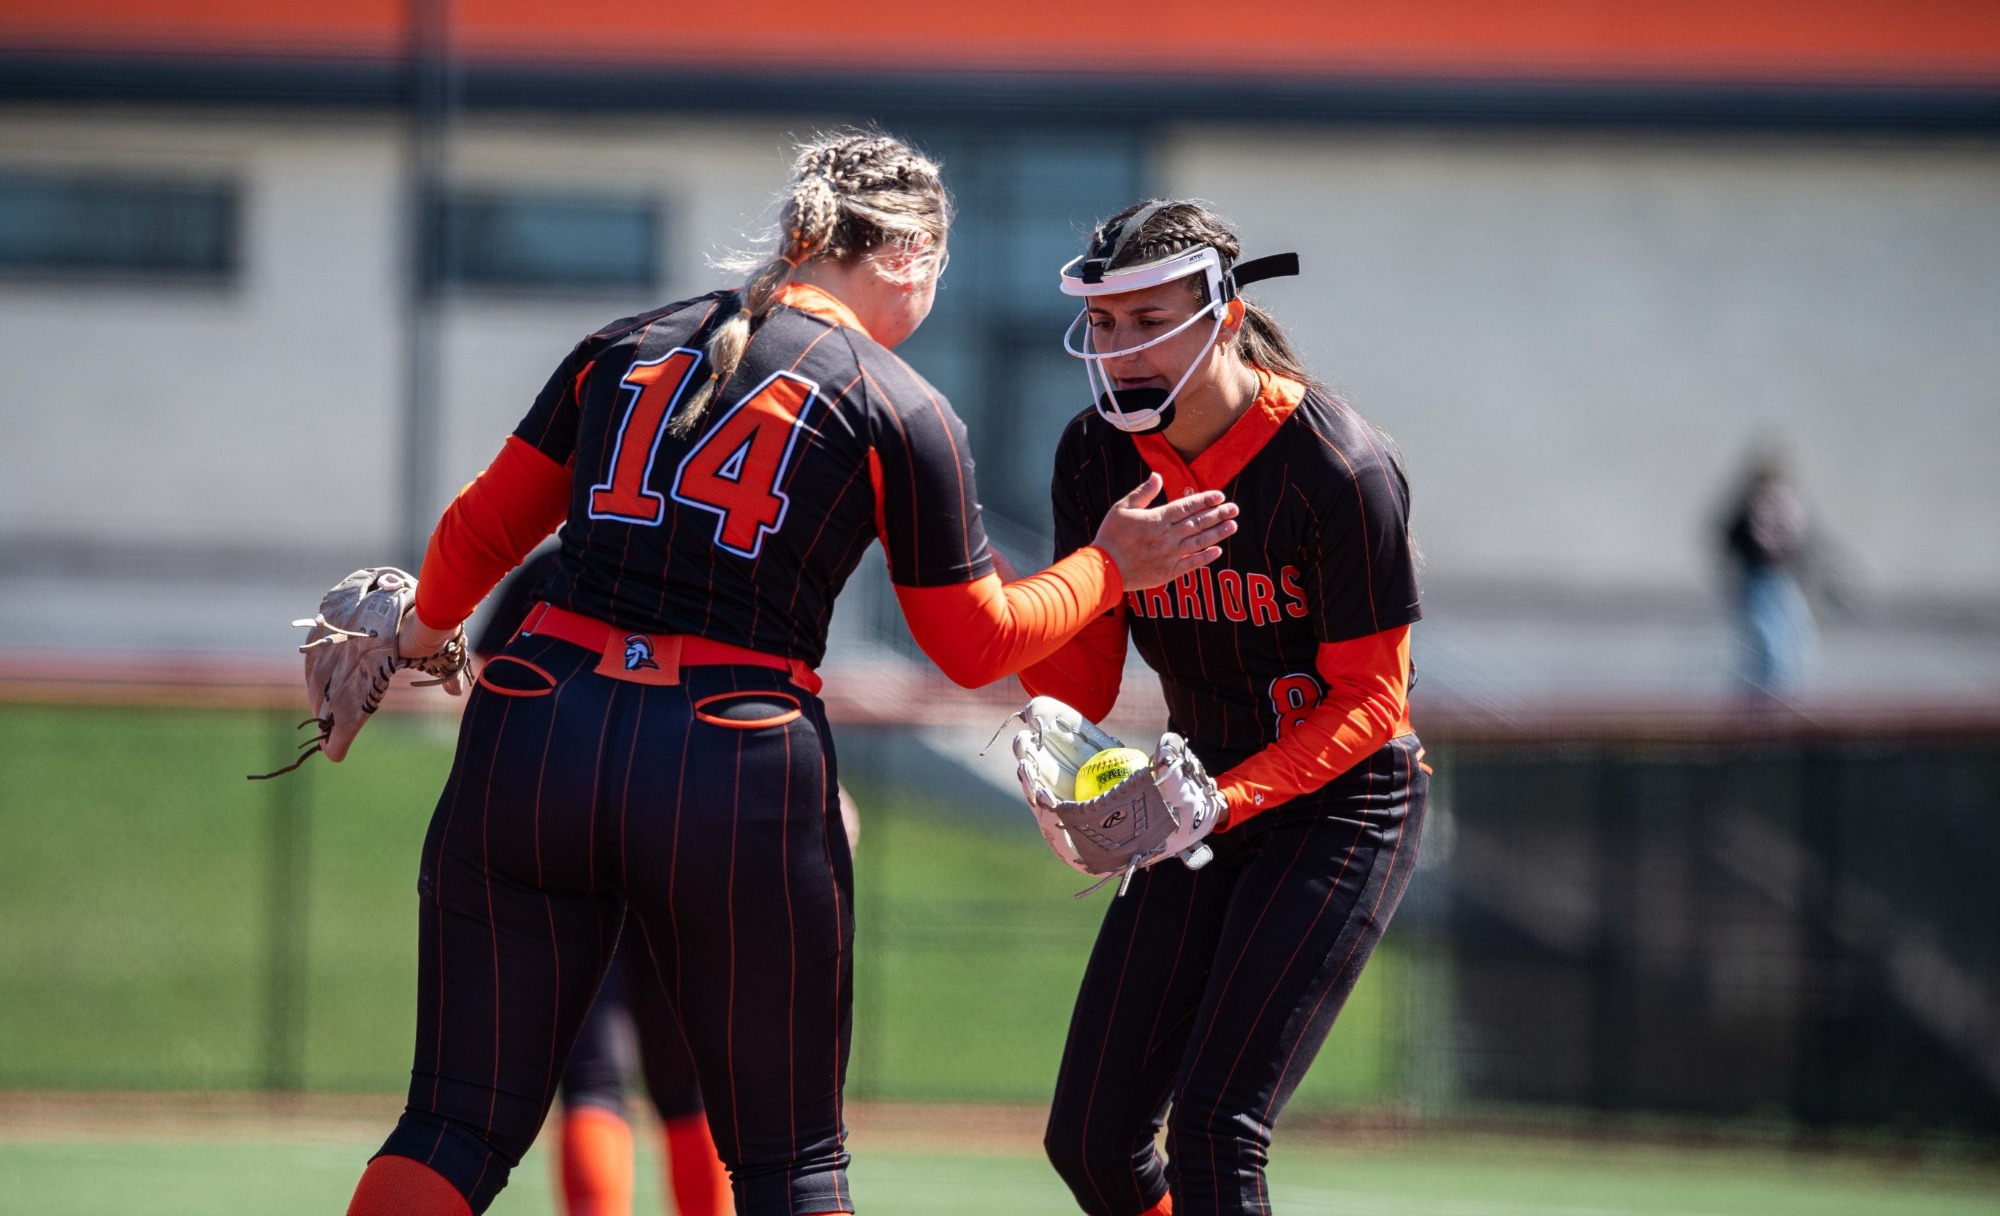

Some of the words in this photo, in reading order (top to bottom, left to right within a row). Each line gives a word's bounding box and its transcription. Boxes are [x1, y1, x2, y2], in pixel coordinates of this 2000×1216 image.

[589, 347, 819, 558] 14
[1128, 565, 1309, 627] RRIORS
[1269, 672, 1323, 742] 8
